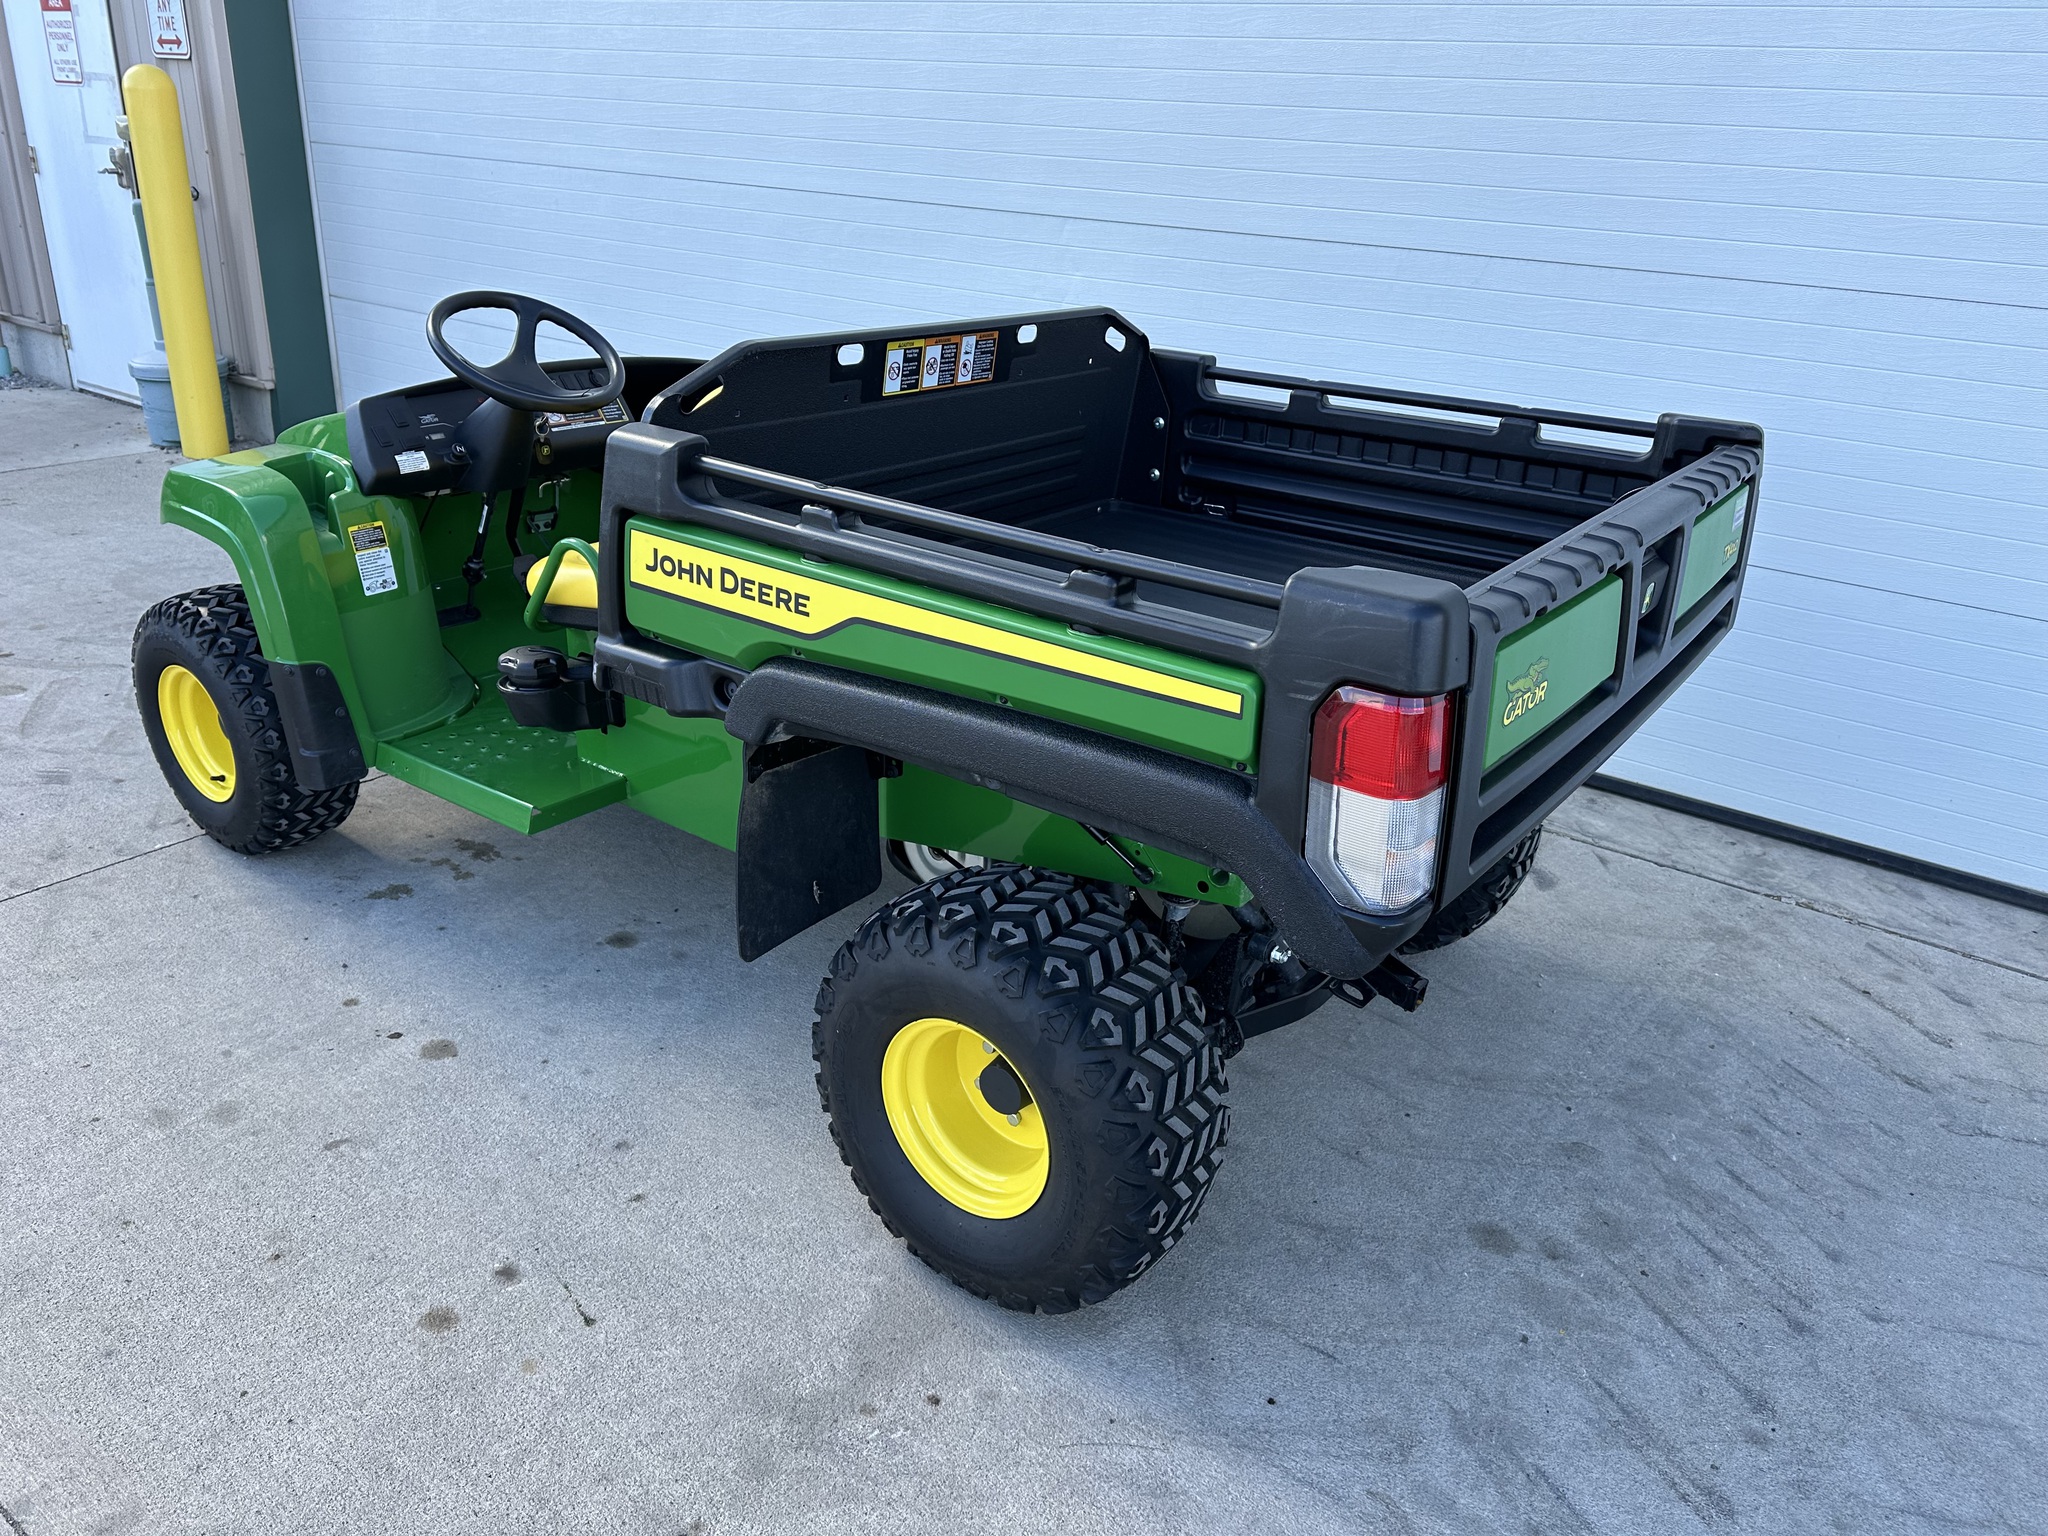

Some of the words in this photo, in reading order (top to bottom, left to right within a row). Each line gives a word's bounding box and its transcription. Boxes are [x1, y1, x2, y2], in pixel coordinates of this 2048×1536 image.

[157, 0, 171, 12] ANY
[157, 16, 177, 31] TIME
[645, 548, 713, 589] JOHN
[720, 566, 811, 618] DEERE
[1503, 680, 1549, 726] GATOR
